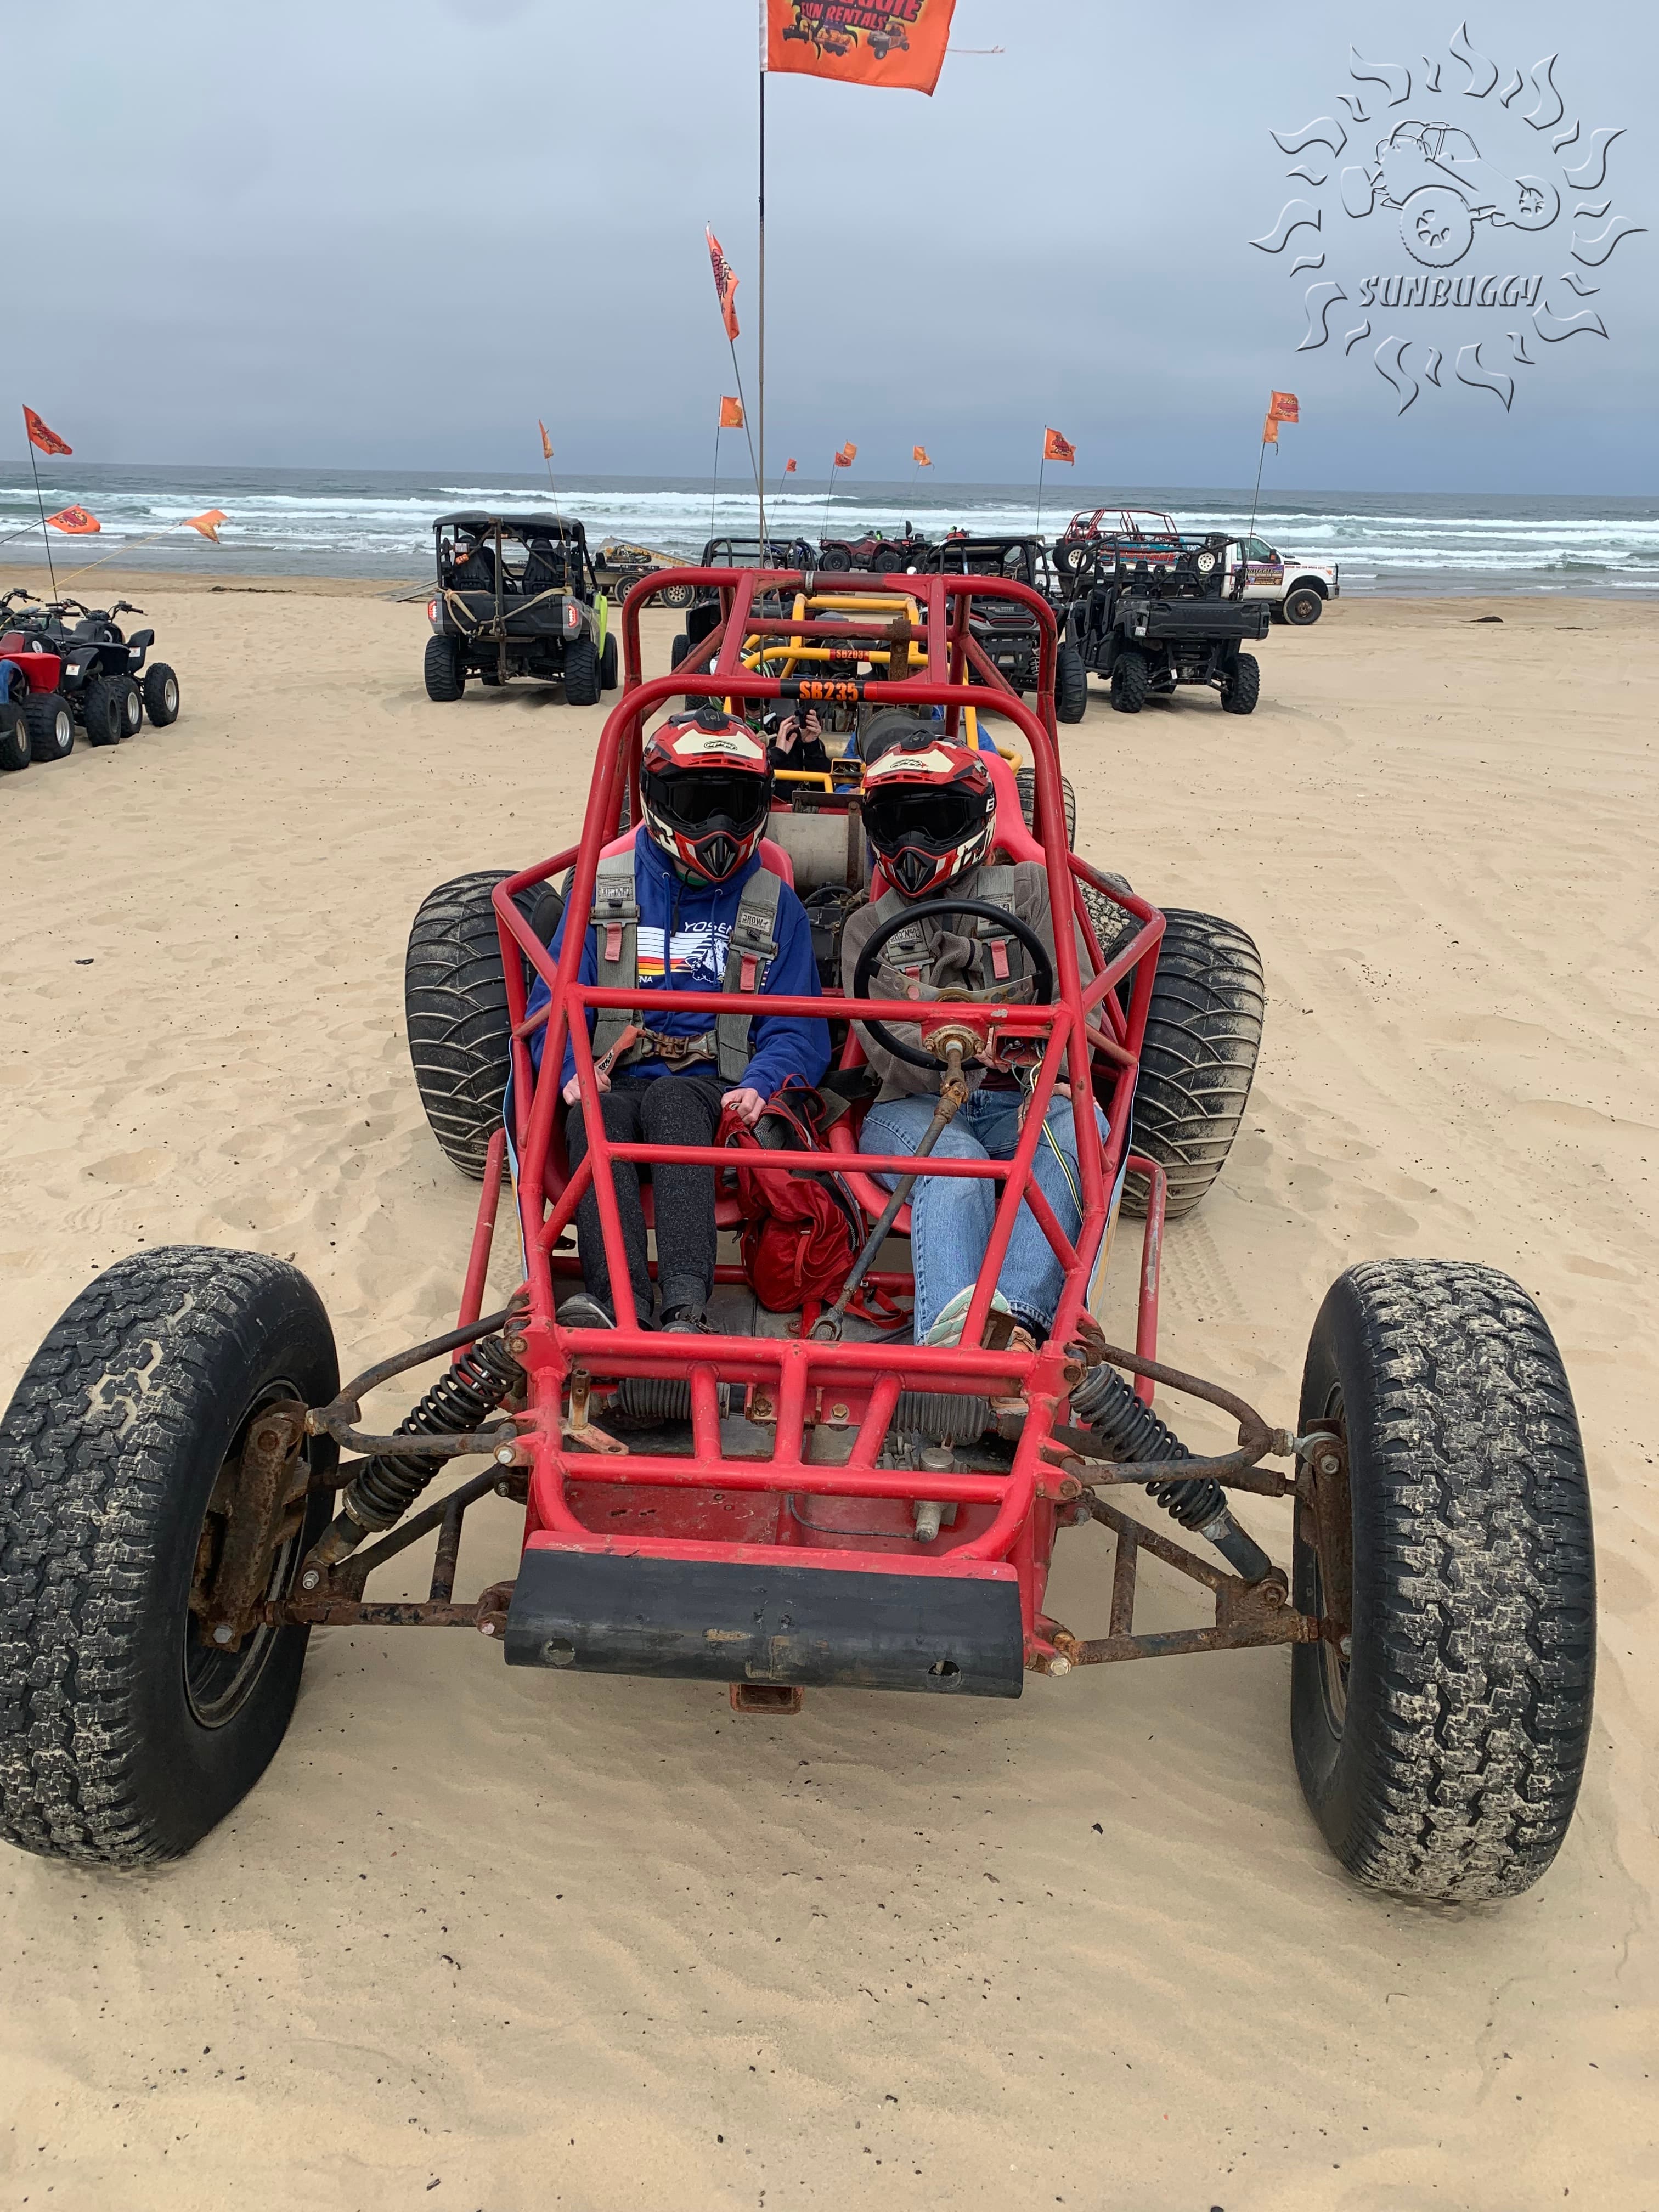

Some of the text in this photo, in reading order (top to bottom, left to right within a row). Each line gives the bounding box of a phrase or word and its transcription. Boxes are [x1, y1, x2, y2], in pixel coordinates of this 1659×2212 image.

[801, 2, 823, 19] FUN
[825, 5, 888, 30] RENTALS
[835, 649, 864, 659] SB203
[799, 680, 859, 701] SB235
